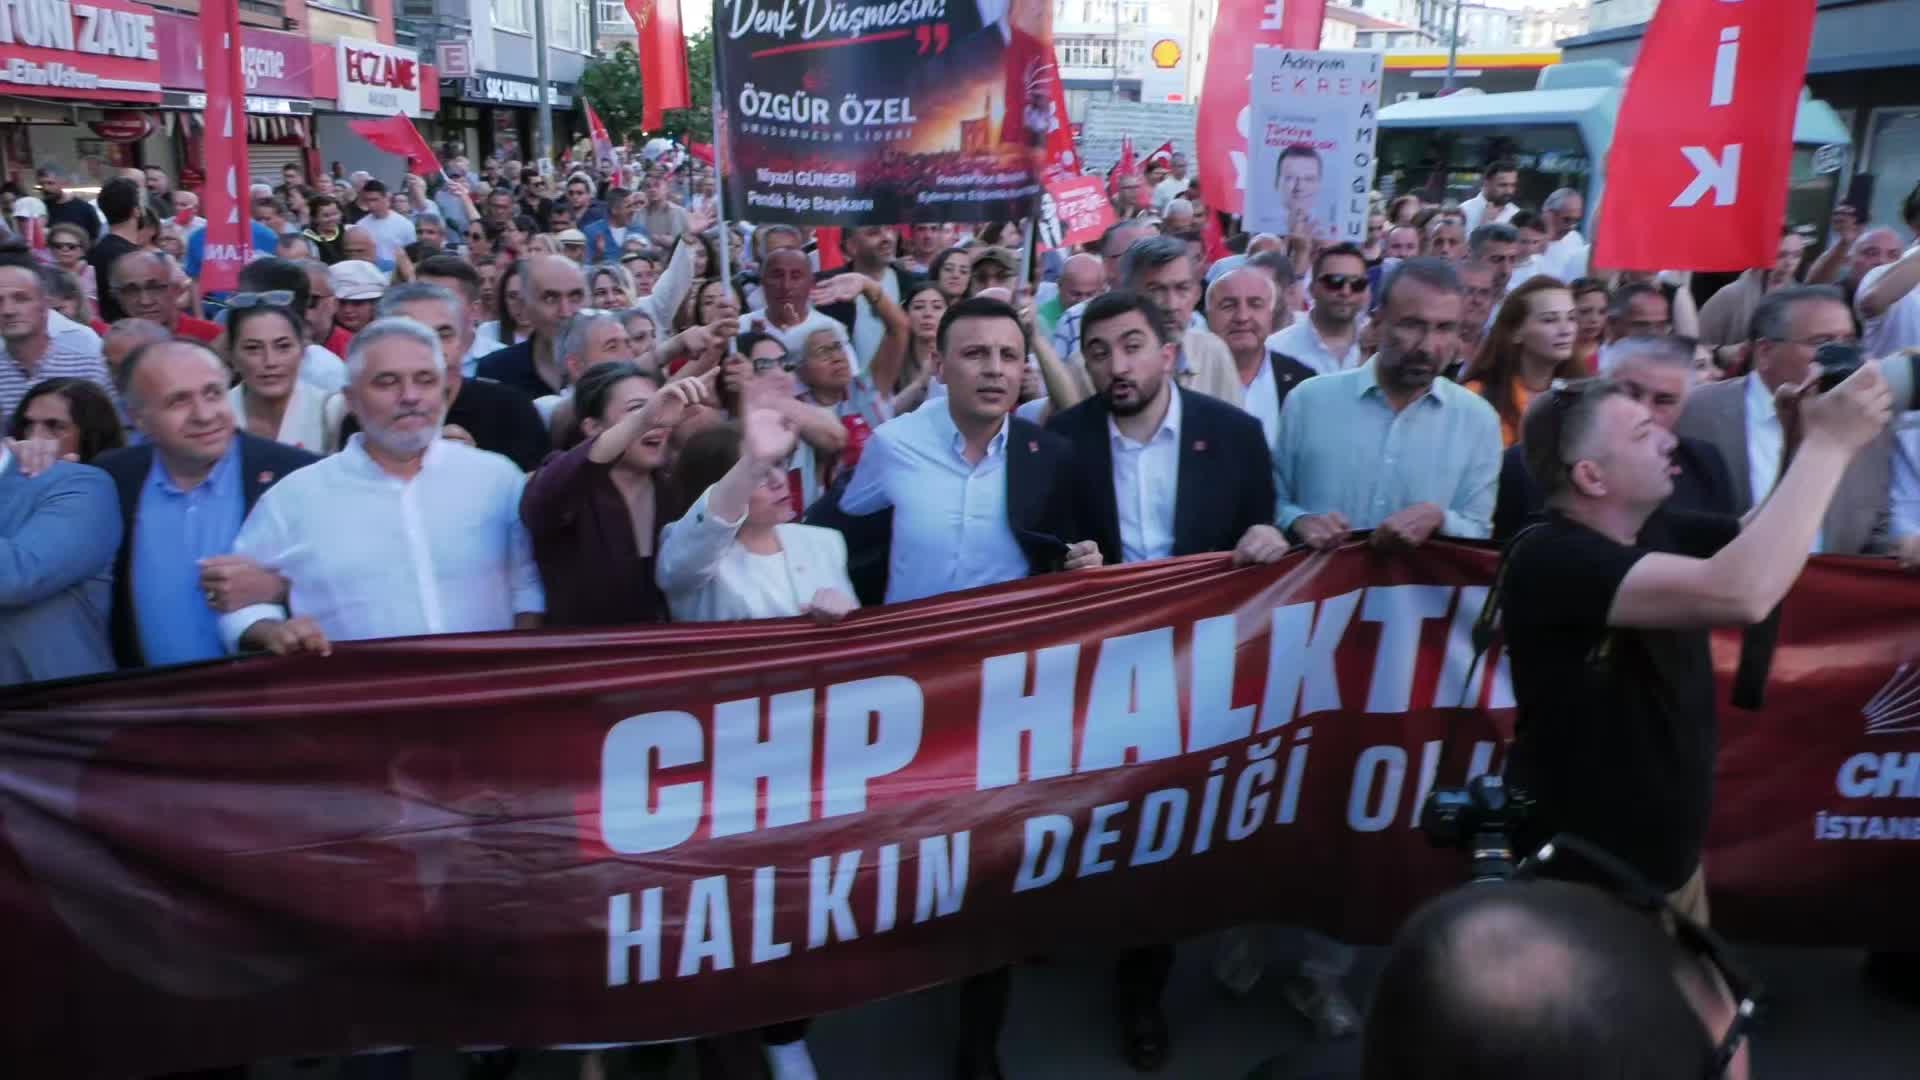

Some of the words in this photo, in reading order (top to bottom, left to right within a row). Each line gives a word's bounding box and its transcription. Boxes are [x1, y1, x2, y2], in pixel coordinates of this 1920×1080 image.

[73, 4, 158, 60] ZADE
[724, 0, 796, 39] Denk
[345, 46, 417, 91] ECZANE
[1271, 74, 1377, 95] EKREM
[739, 82, 830, 125] ÖZGÜR
[839, 94, 917, 126] ÖZEL
[601, 674, 924, 855] CHP
[976, 585, 1517, 791] HALKTI
[607, 830, 971, 986] HALKIN
[1013, 727, 1312, 893] DEDİĞİ
